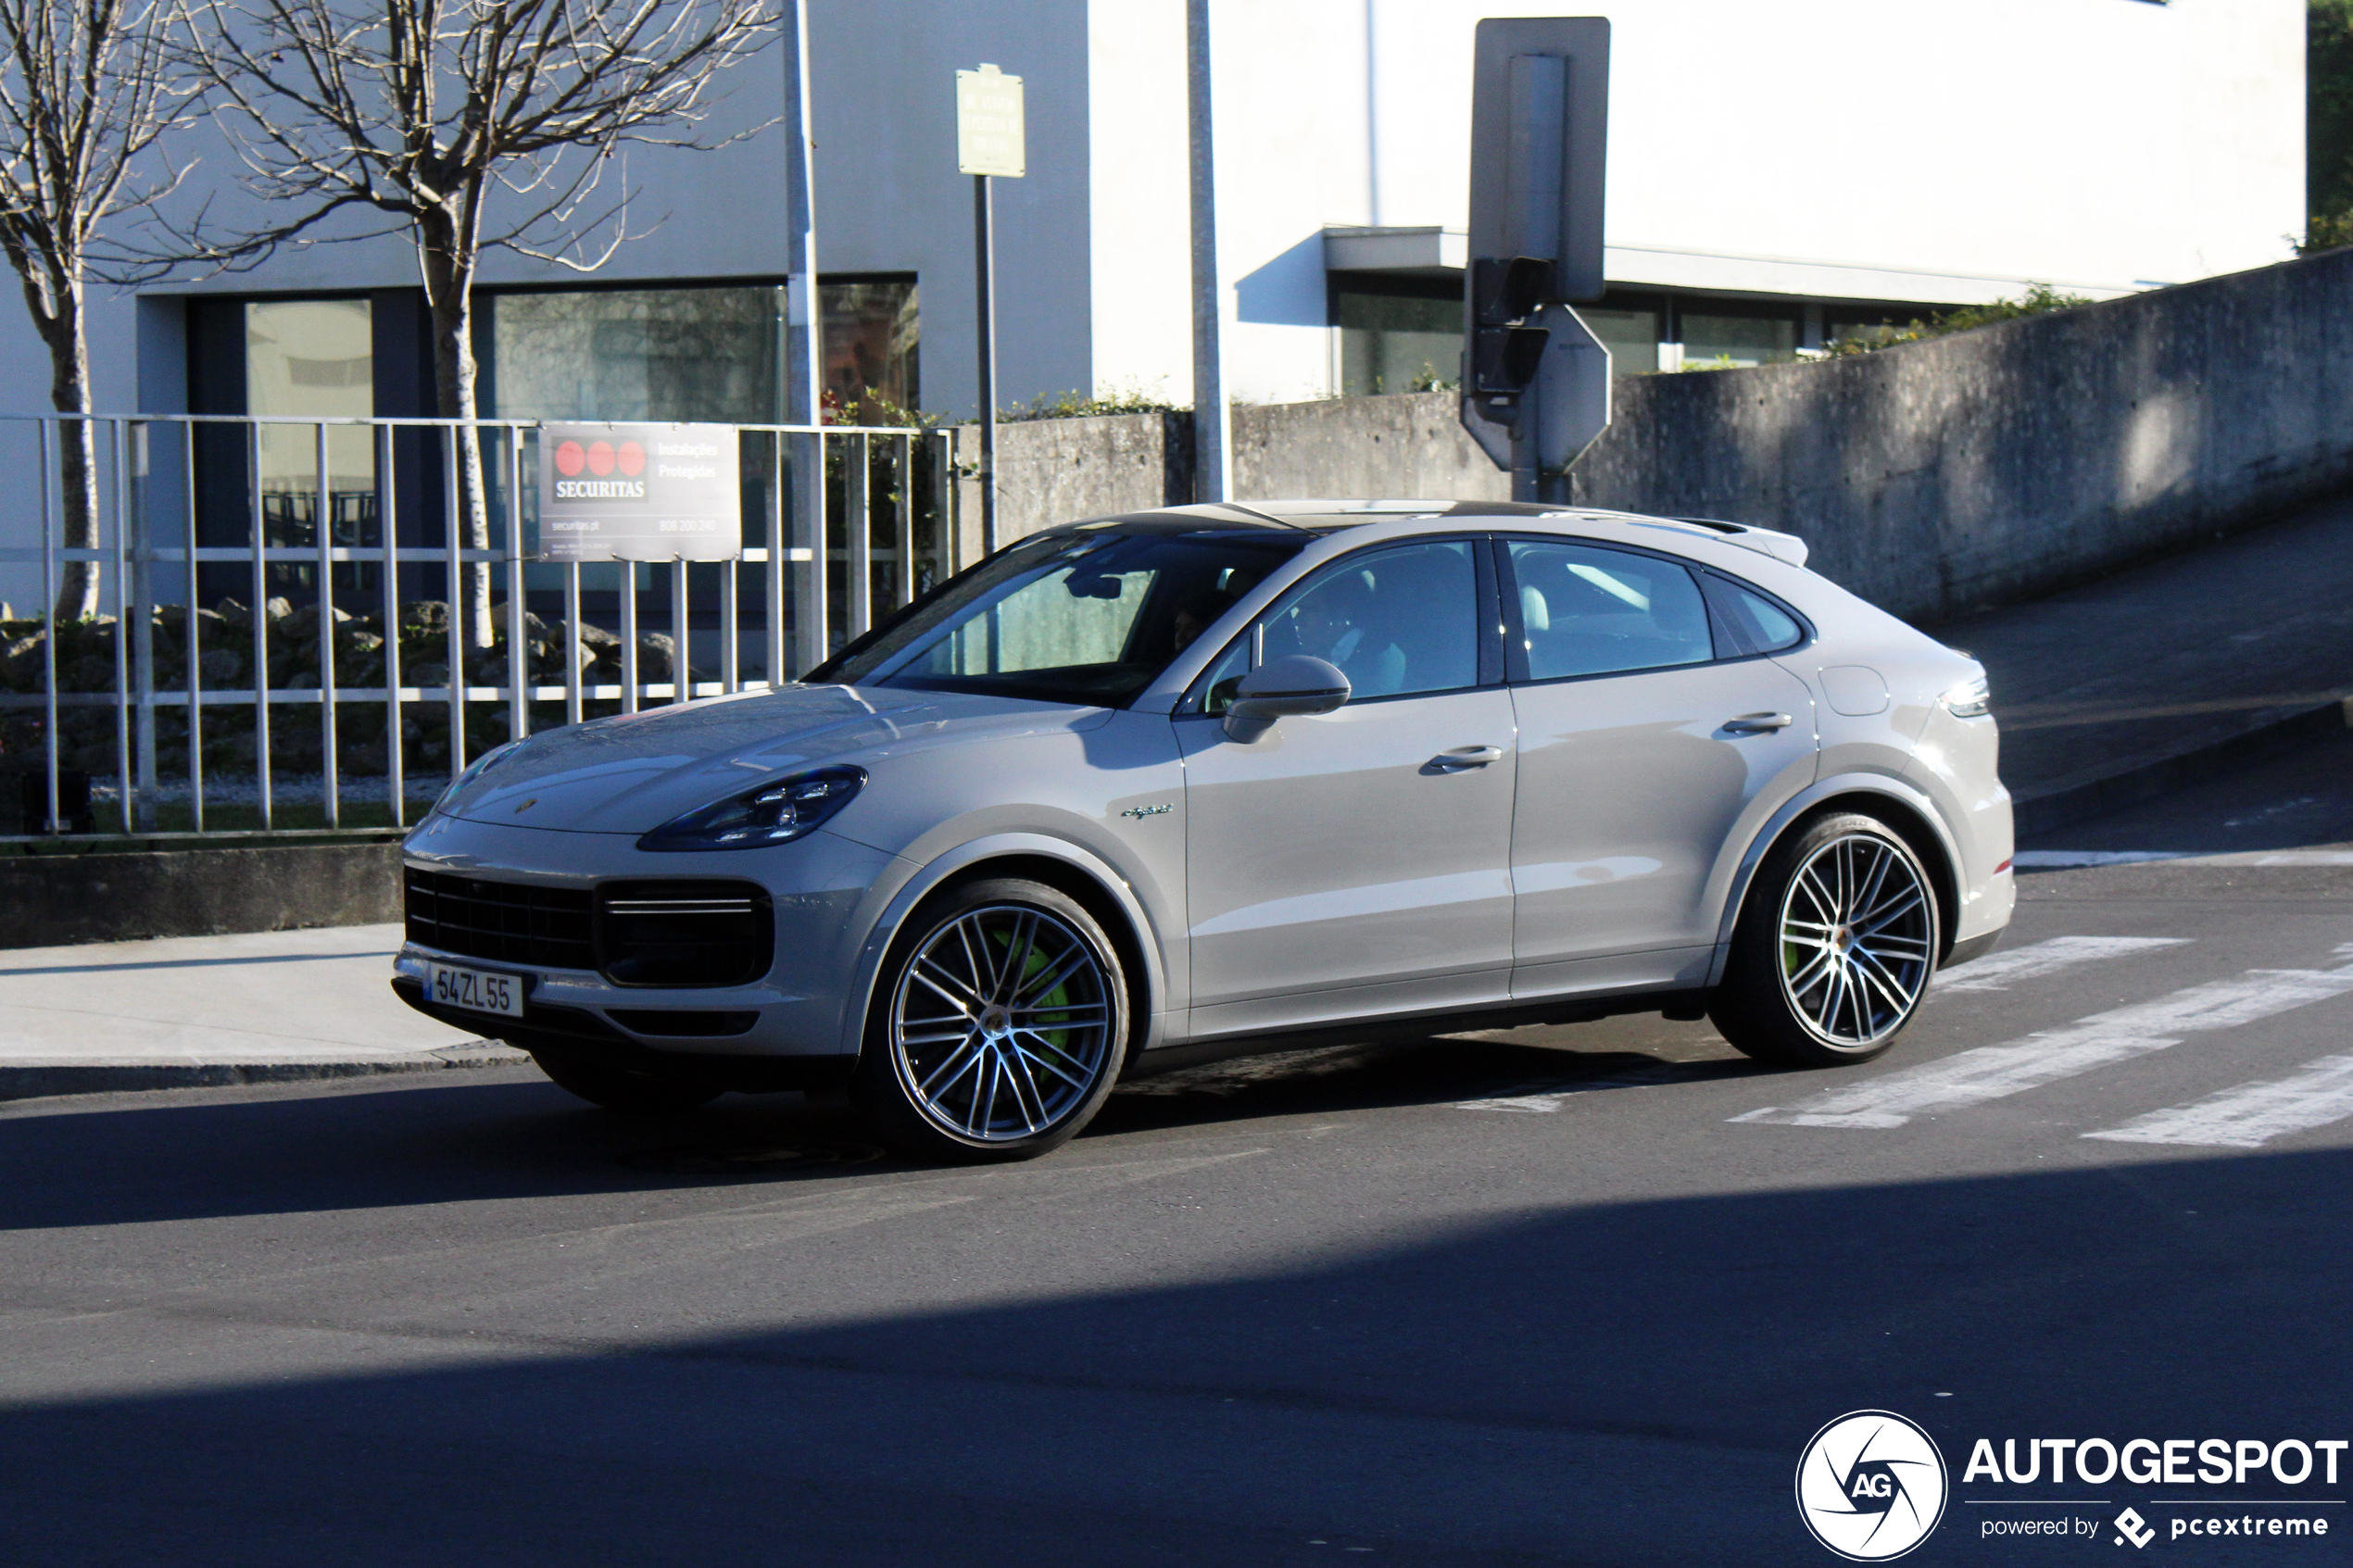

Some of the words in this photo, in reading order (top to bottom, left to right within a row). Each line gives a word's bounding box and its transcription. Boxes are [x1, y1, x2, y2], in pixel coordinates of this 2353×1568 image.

[658, 443, 718, 459] Instalações
[658, 464, 716, 480] Protegidas
[556, 481, 645, 498] SECURITAS
[679, 520, 697, 532] 200
